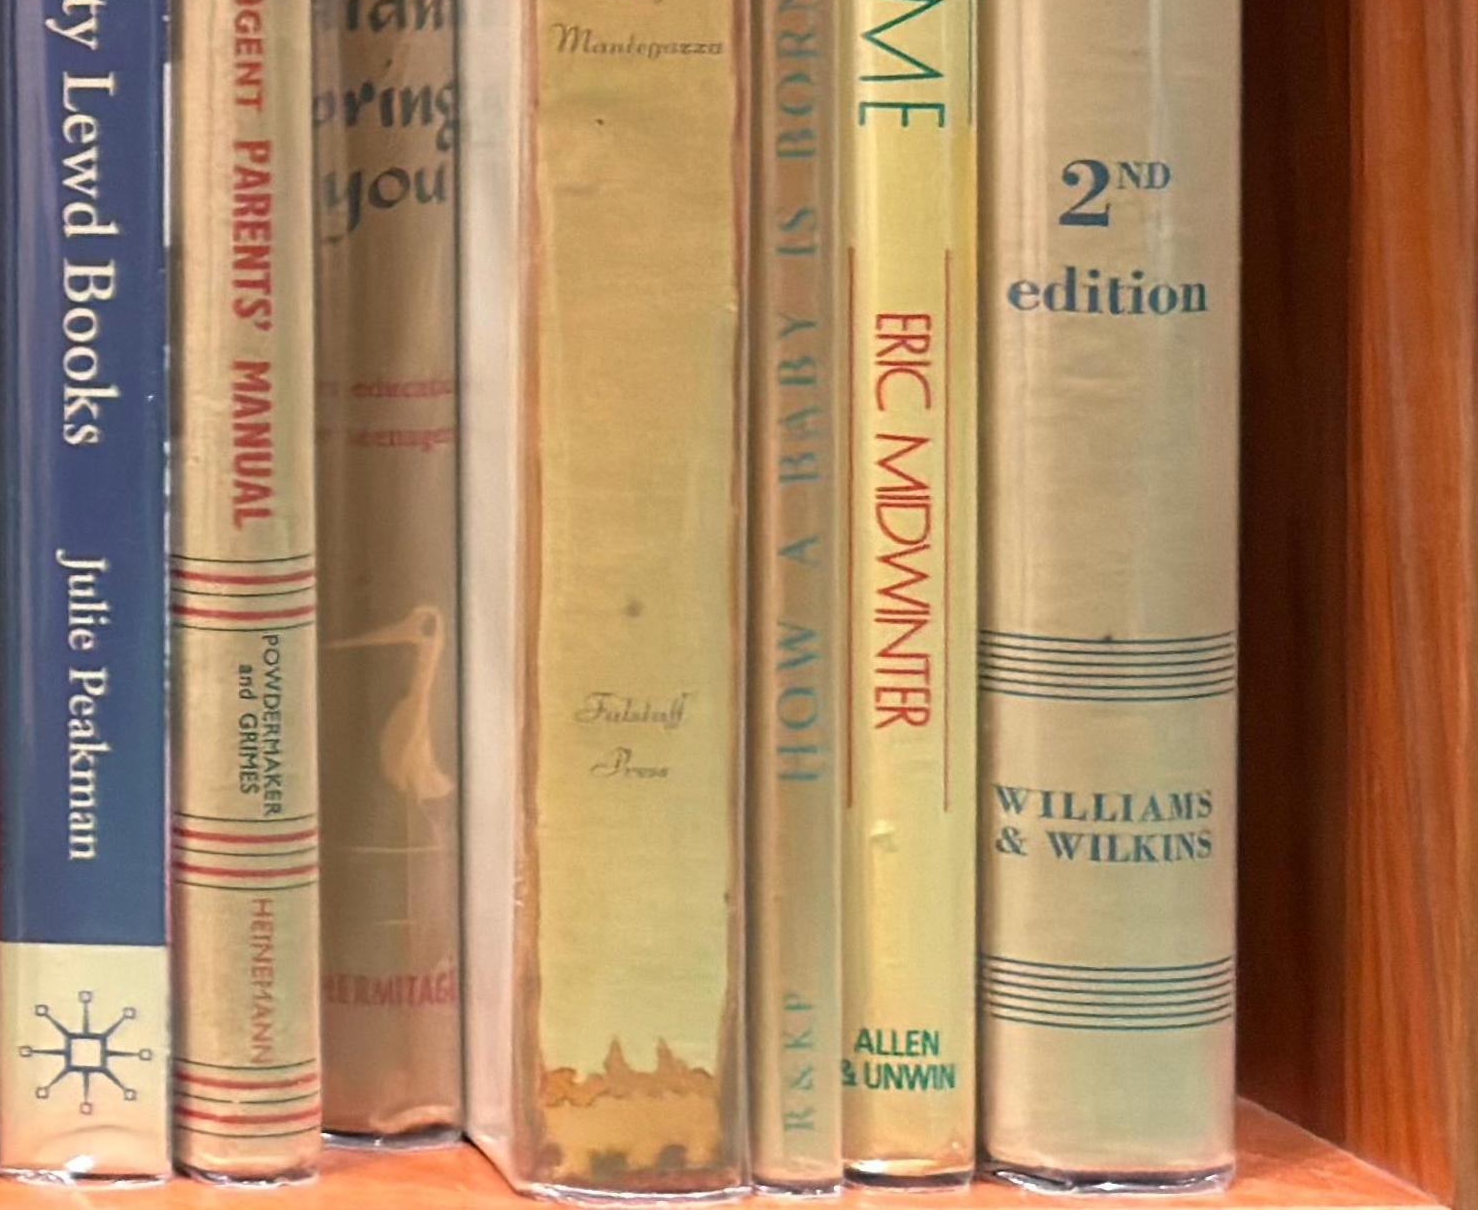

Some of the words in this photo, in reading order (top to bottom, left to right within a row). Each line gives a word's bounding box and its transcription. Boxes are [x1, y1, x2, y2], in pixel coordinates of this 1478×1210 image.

[63, 70, 119, 238] Lewd
[1008, 265, 1207, 315] edition
[63, 257, 119, 446] Books
[874, 312, 931, 412] ERIC
[57, 549, 111, 651] Julie
[873, 432, 931, 729] MIDWINTER
[68, 669, 111, 862] Peakman
[239, 713, 260, 795] GRIMES
[993, 784, 1212, 822] WILLIAMS
[1047, 829, 1212, 863] WILKINS
[854, 1027, 939, 1056] ALLEN
[864, 1061, 956, 1091] UNWIN
